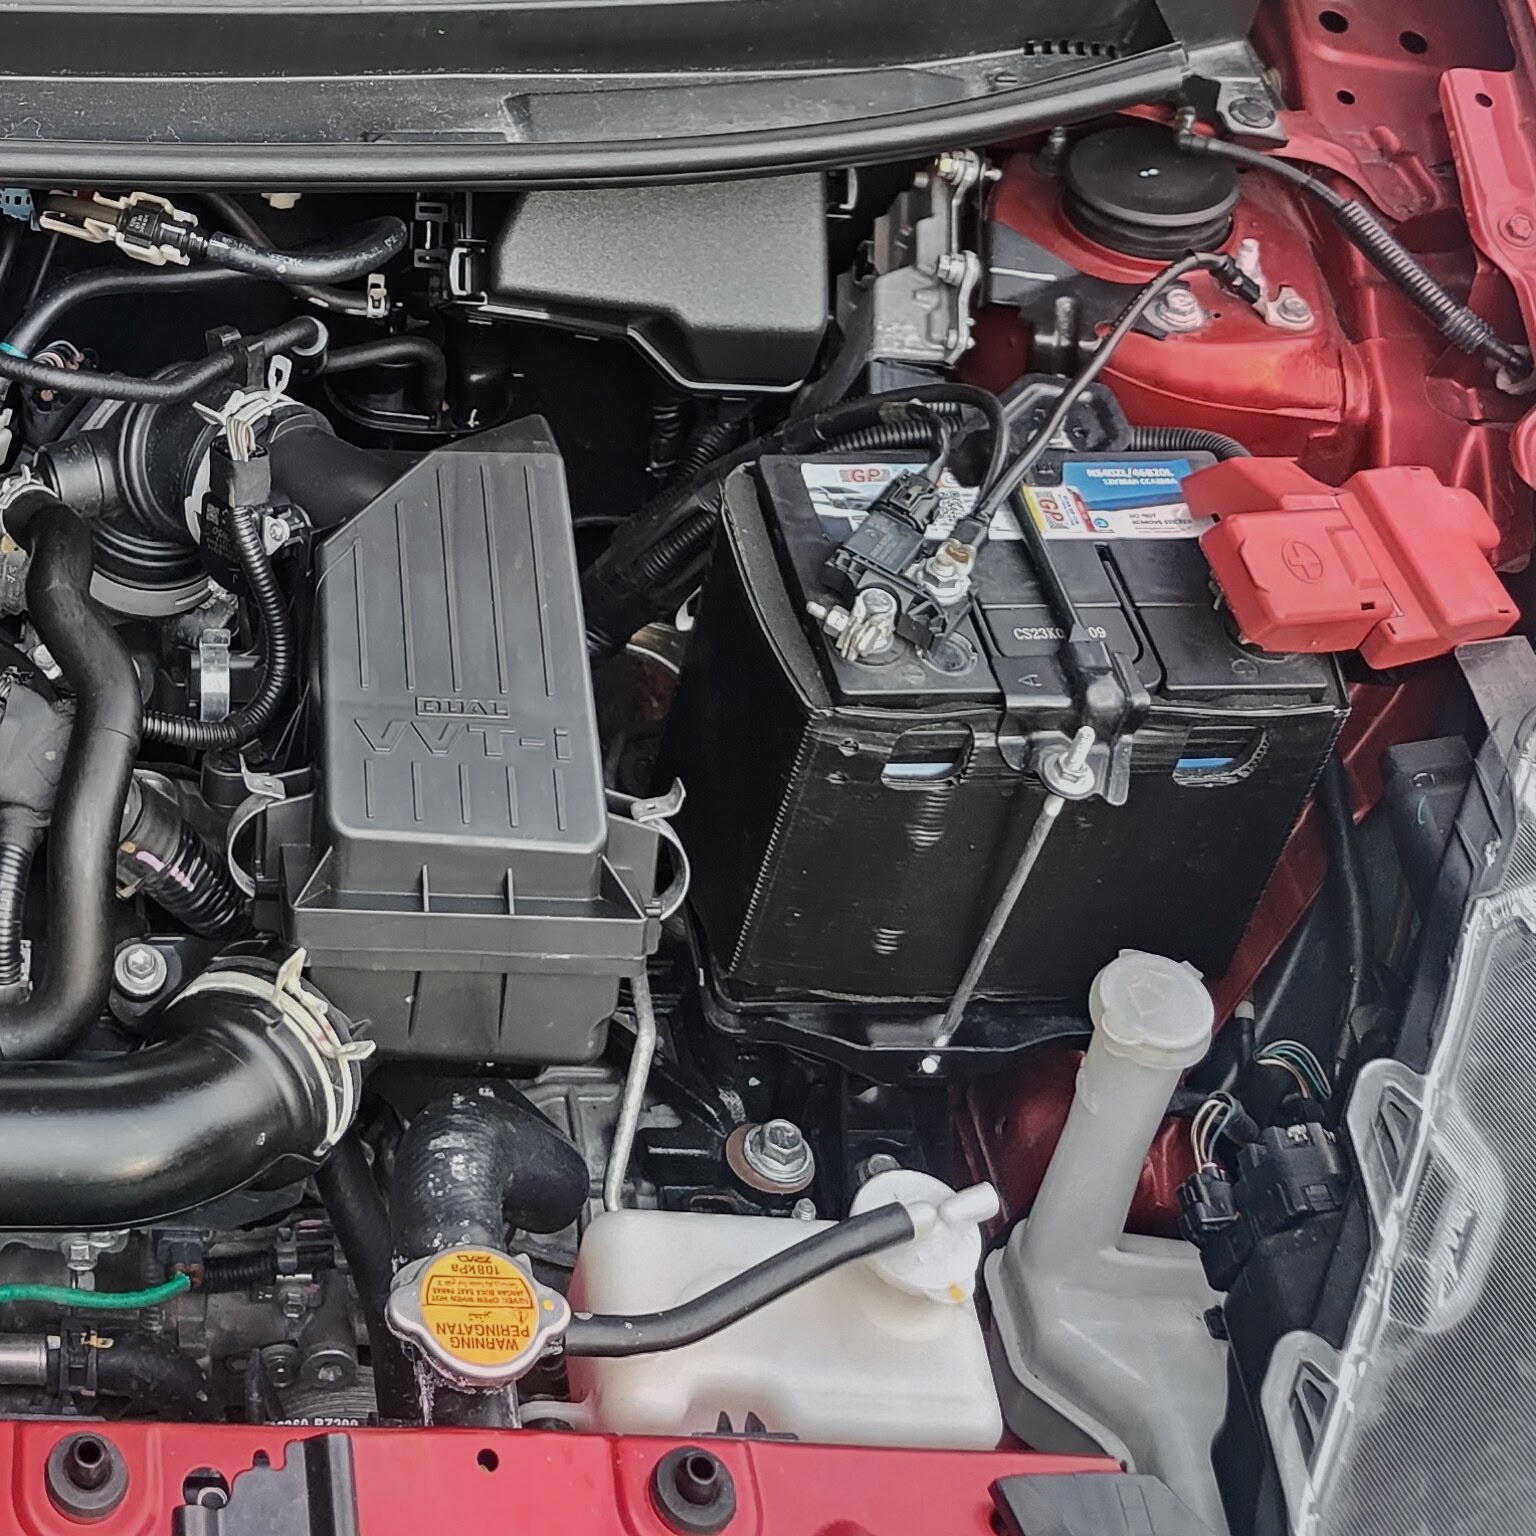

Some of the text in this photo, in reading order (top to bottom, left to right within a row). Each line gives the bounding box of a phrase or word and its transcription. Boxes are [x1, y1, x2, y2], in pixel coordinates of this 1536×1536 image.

[851, 469, 880, 482] GP
[1039, 497, 1065, 523] GP
[1087, 626, 1107, 639] 09
[421, 700, 509, 716] DUAL
[354, 717, 573, 761] VVT-i
[451, 1264, 500, 1275] 108kPa
[477, 1296, 498, 1304] OPEN
[435, 1322, 530, 1337] PERINGATAN
[449, 1336, 519, 1351] WARNING
